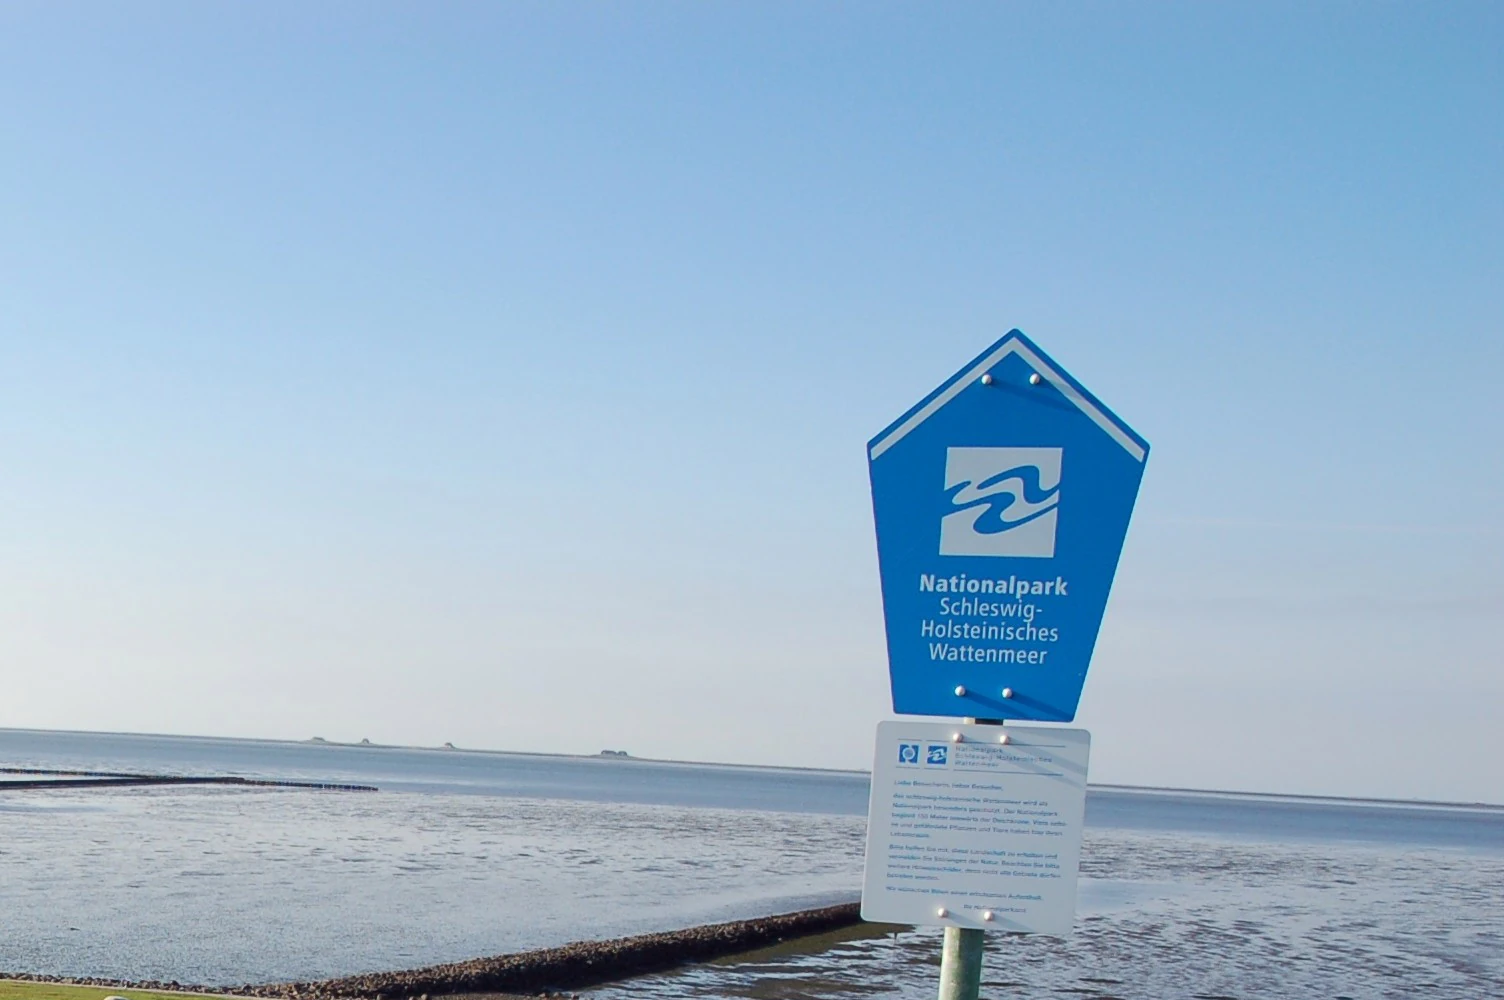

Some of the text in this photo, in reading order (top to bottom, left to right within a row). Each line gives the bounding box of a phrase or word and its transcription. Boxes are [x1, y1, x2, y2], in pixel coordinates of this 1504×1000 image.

[919, 573, 1068, 599] Nationalpark
[939, 596, 1042, 622] Schleswig-
[921, 618, 1059, 642] Holsteinisches
[929, 642, 1048, 664] Wattenmeer
